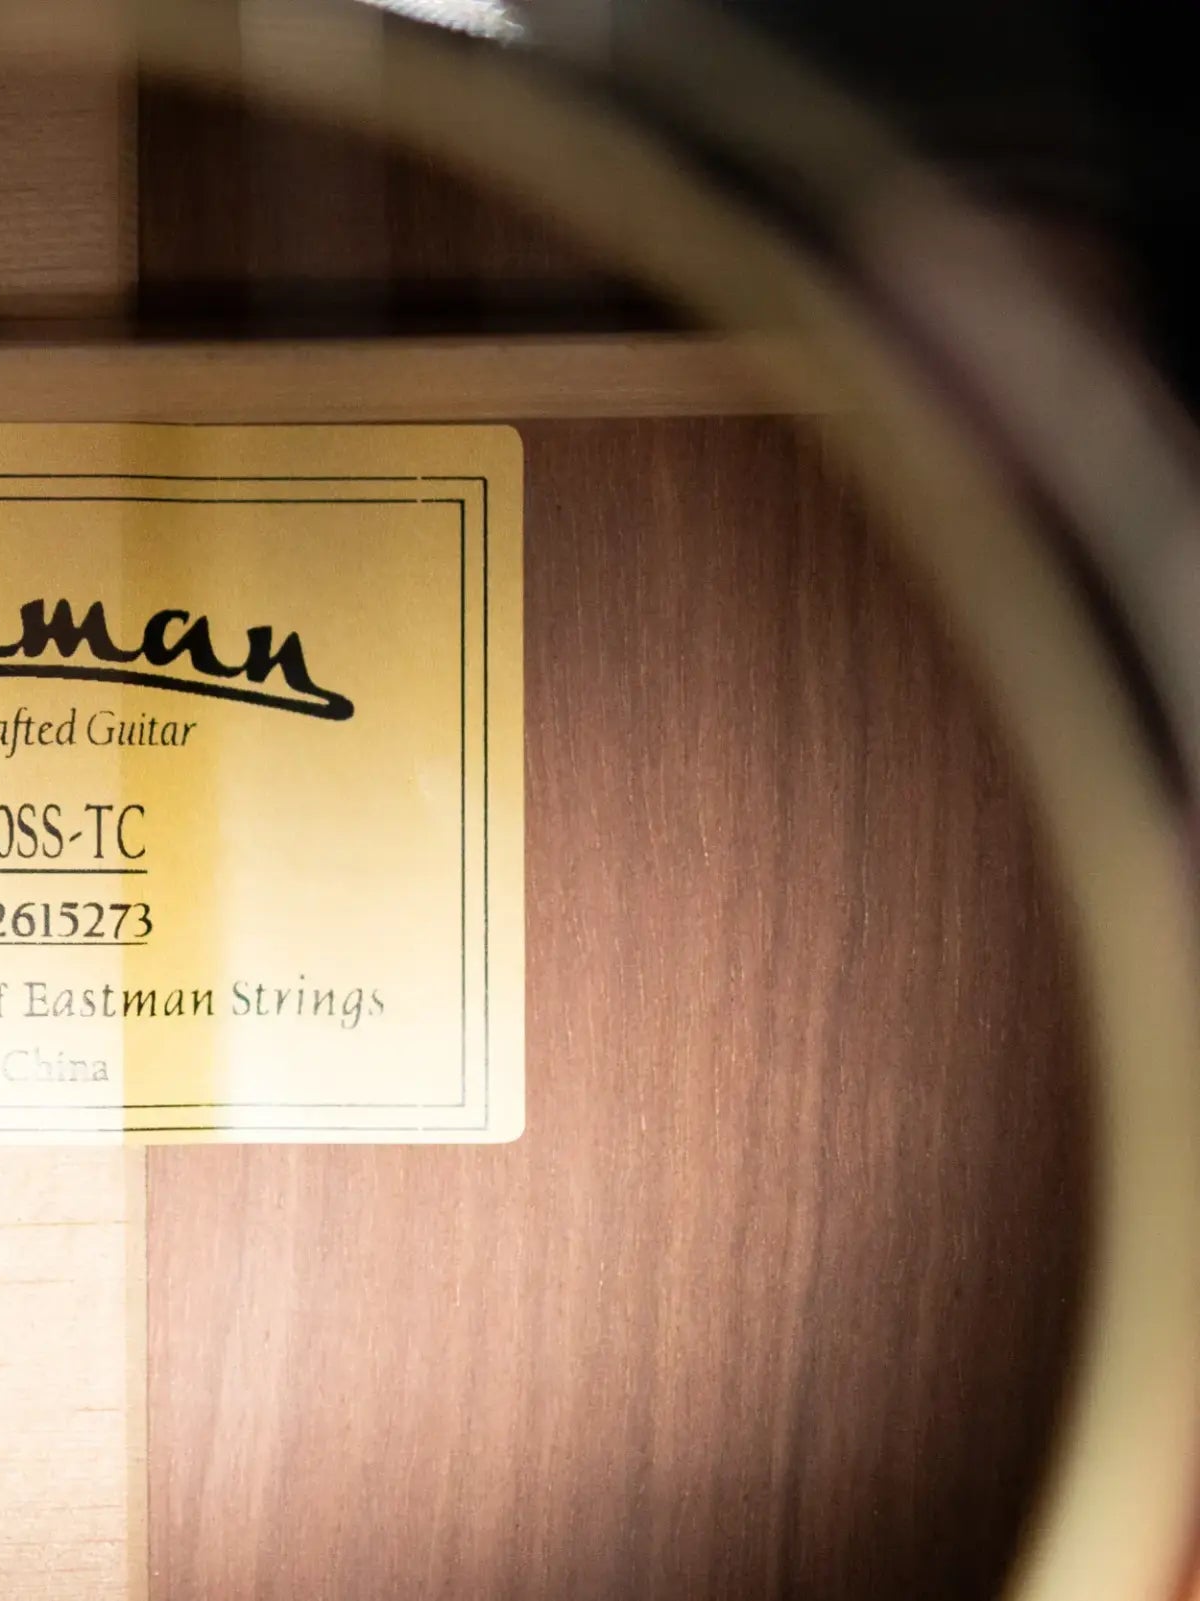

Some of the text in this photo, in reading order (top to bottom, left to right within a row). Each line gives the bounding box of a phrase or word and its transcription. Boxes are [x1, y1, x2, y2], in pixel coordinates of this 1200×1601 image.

[86, 710, 197, 747] Guitar
[24, 982, 215, 1018] Eastman
[231, 974, 385, 1029] Strings
[2, 1047, 109, 1083] China
